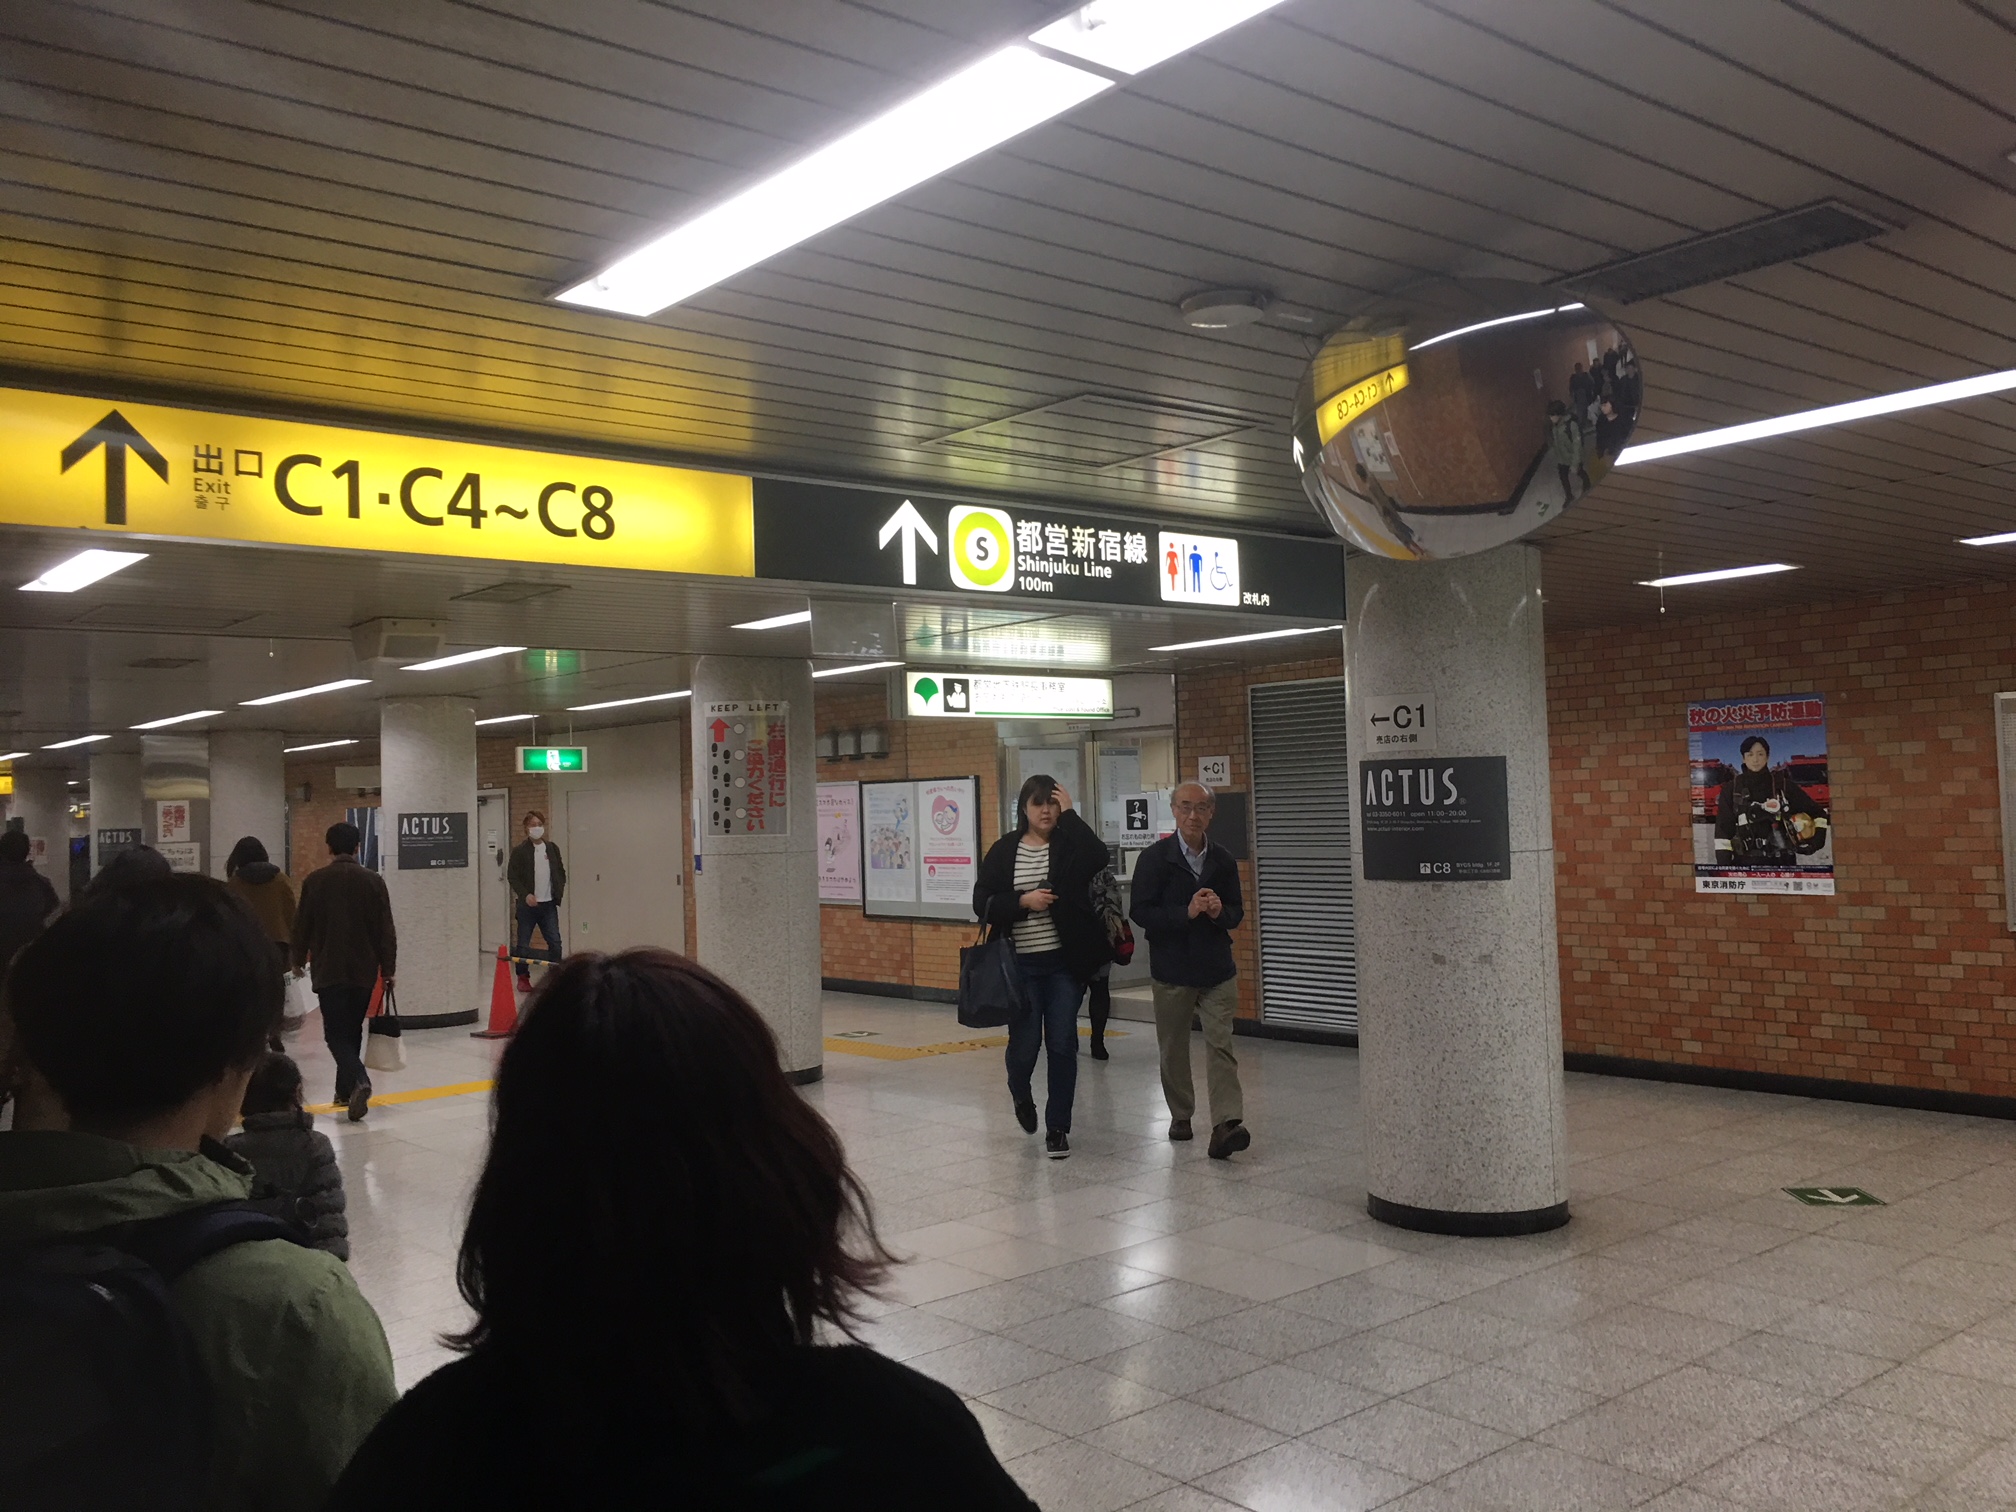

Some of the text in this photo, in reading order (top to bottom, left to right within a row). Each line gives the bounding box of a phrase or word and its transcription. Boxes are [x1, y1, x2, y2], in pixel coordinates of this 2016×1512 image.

[194, 444, 263, 478] 出口
[194, 478, 231, 494] Exit
[976, 536, 990, 562] S
[1016, 520, 1149, 564] 都営新宿線
[1018, 554, 1113, 579] Shinjuku Line
[1018, 576, 1054, 593] 100m
[1243, 592, 1270, 607] 改札内
[711, 703, 779, 712] KEEP LEFT
[1393, 703, 1425, 729] C1
[1688, 699, 1823, 727] 秋の火災予防運動
[1376, 733, 1418, 745] 売店の右側
[767, 722, 787, 808] 左側通行に
[1211, 762, 1225, 774] C1
[1366, 767, 1458, 806] ACTUS
[402, 817, 450, 835] ACTUS
[99, 831, 132, 844] ACTUS
[1433, 862, 1451, 874] C8
[1702, 880, 1746, 890] 東京消防庁
